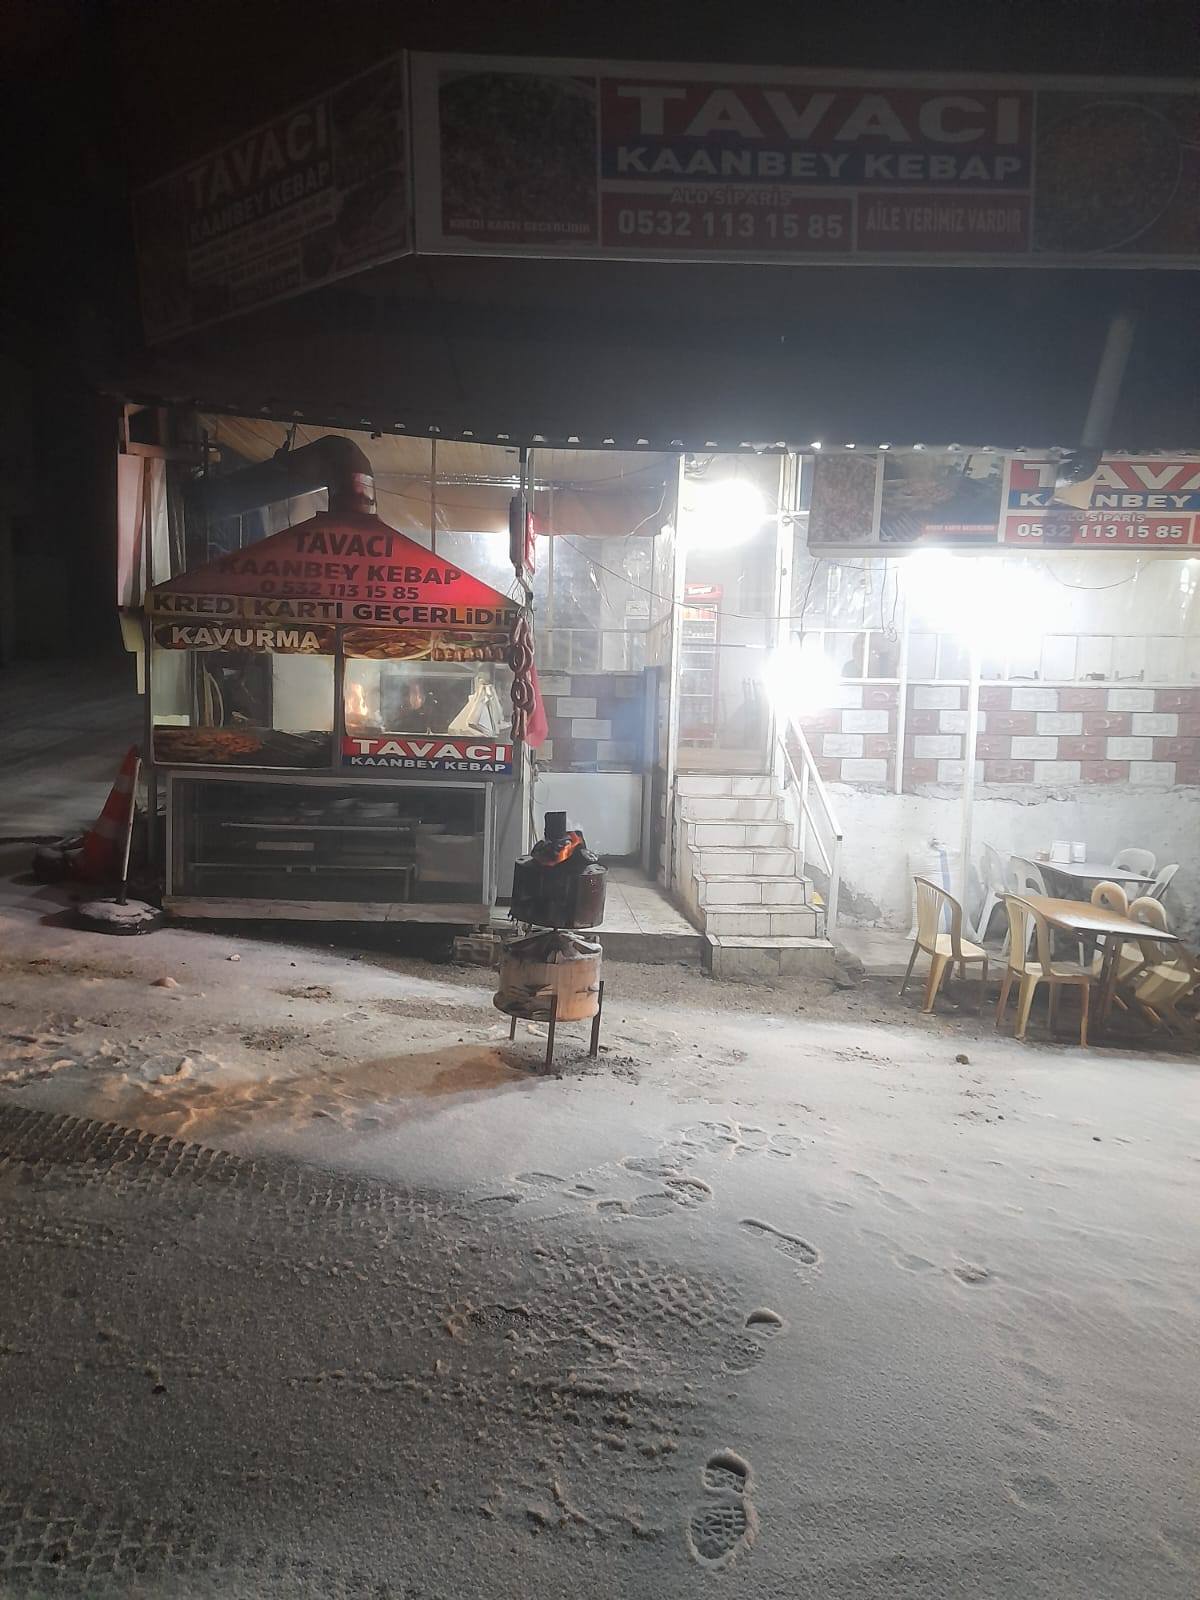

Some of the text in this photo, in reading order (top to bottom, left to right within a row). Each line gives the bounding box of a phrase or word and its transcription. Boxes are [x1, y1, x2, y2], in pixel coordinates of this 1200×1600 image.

[616, 87, 1021, 145] TAVACI
[187, 103, 329, 209] TAVACI
[616, 146, 1022, 182] KAANBEY KEBAP
[269, 160, 331, 209] KEBAP
[670, 189, 708, 204] ALO
[617, 208, 843, 239] 0532 113 15 85
[865, 200, 900, 232] AİLE
[968, 207, 1022, 234] VARDIR
[1020, 492, 1192, 509] KNBEY
[1017, 523, 1183, 538] 0532 113 15 85
[296, 529, 393, 558] TAVACI
[219, 559, 462, 585] KAANBEY KEBAP
[260, 580, 419, 600] 0 532 113 15 85
[254, 598, 343, 620] KARTI
[171, 626, 321, 650] KAVURMA
[352, 738, 506, 762] TAVACI
[351, 756, 506, 773] KAANBEY KEBAP
